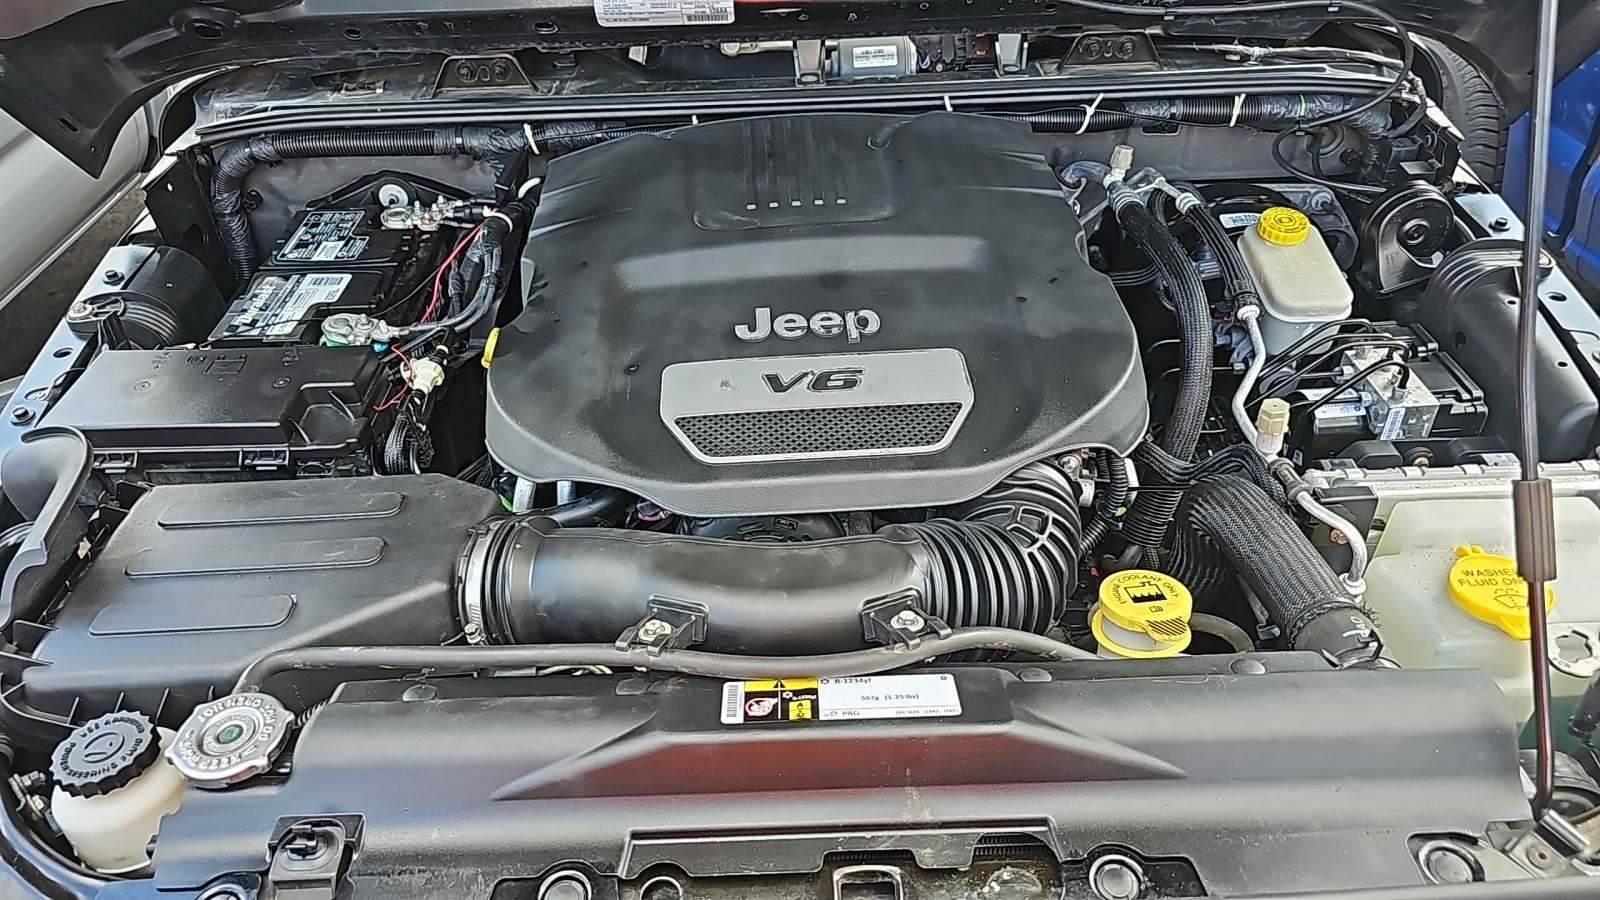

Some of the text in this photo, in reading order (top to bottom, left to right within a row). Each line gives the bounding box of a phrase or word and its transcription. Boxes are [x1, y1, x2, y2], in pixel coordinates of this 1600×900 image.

[734, 307, 881, 344] Jeep
[762, 367, 866, 393] V6
[1458, 578, 1498, 587] FLUID
[1461, 568, 1516, 577] WASHE
[1112, 574, 1179, 604] ENGINE COOLANT ONLY
